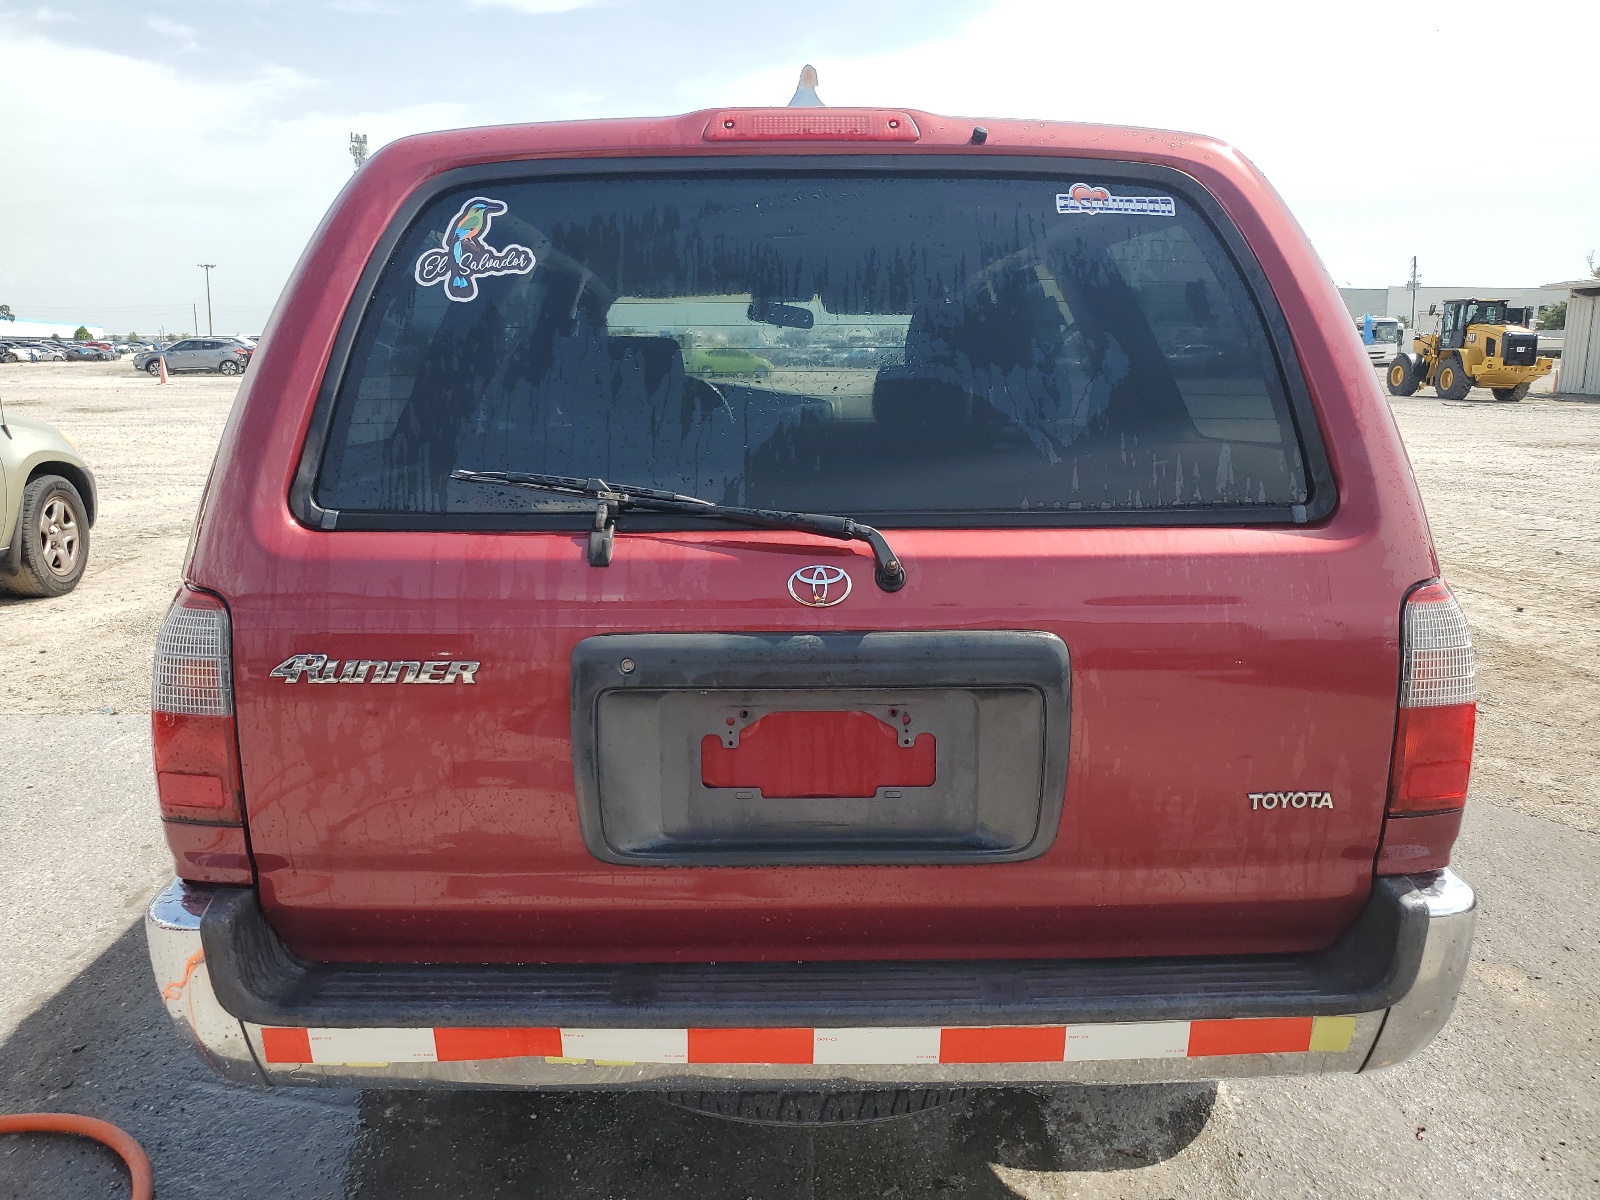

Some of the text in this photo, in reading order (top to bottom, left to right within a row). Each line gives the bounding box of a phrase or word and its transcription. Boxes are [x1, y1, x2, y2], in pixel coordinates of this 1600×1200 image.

[423, 251, 528, 279] El Salvador
[1247, 791, 1334, 810] TOYOTA
